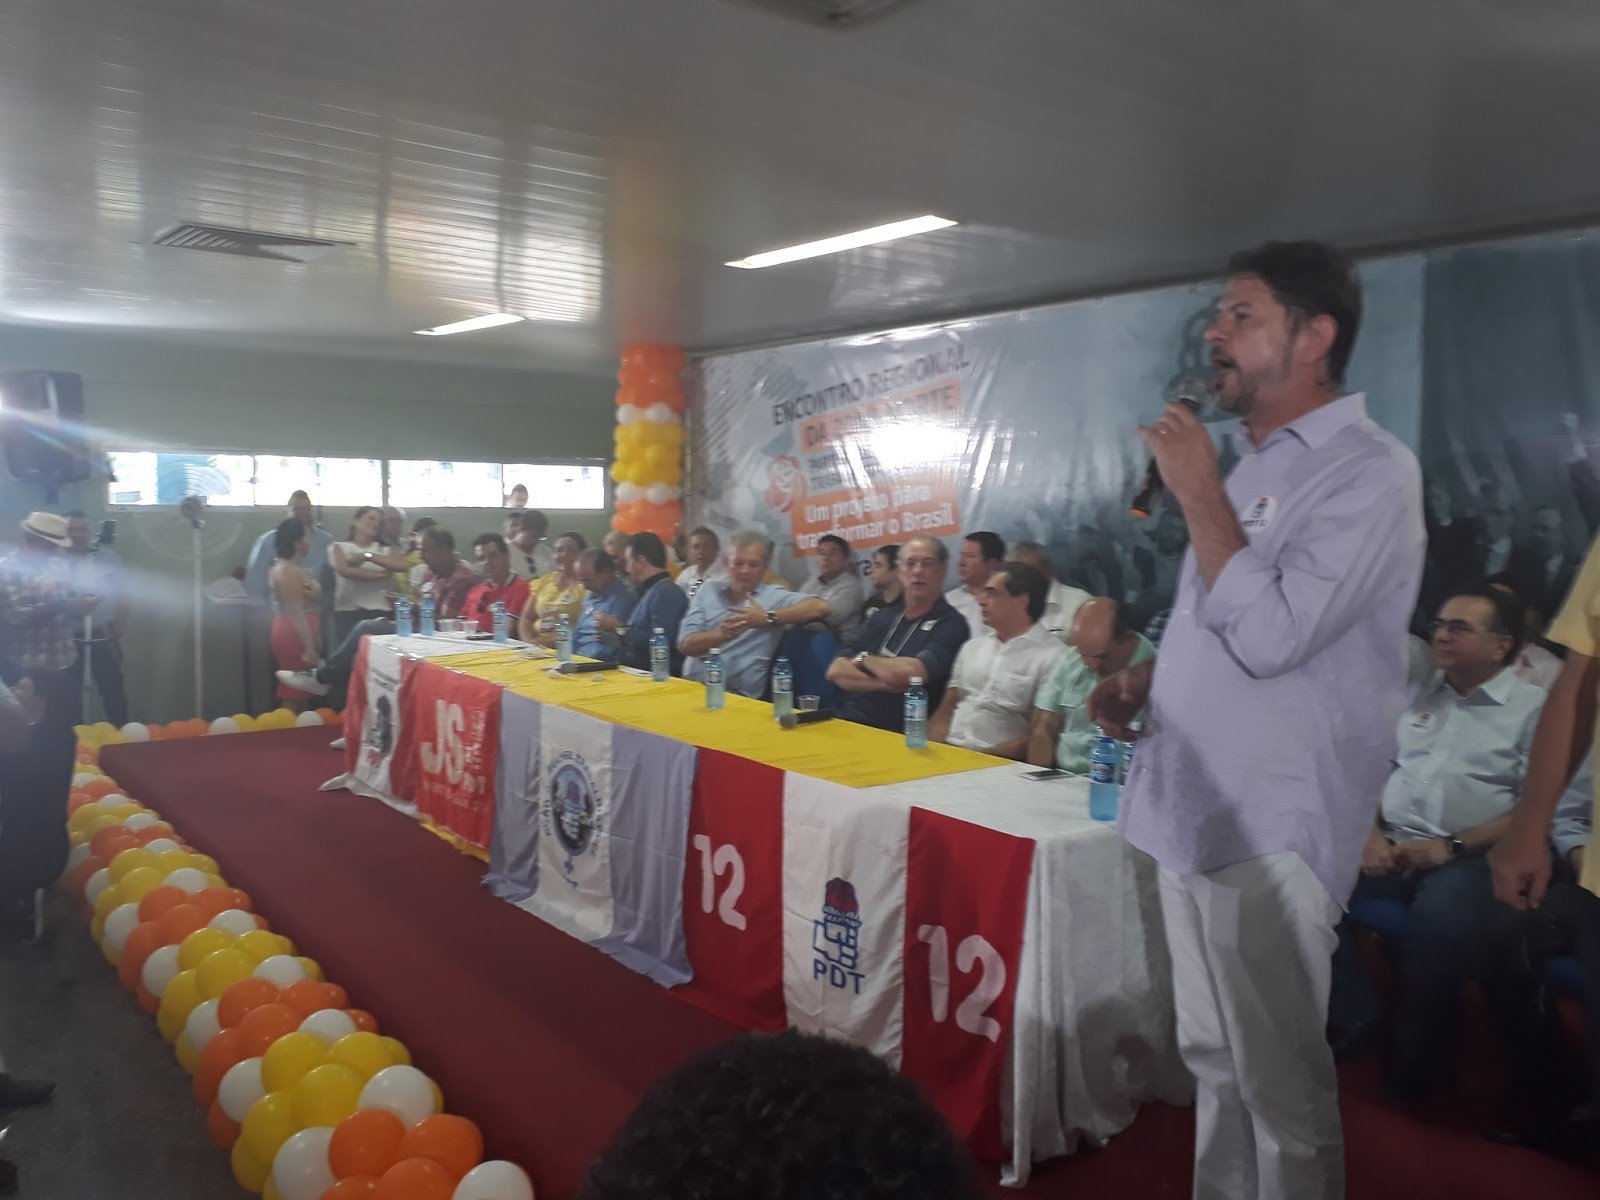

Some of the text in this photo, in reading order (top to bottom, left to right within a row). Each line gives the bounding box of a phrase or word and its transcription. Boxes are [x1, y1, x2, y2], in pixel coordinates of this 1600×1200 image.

[773, 378, 864, 425] ENCONTRO
[804, 504, 830, 523] Um
[886, 518, 900, 535] o
[903, 502, 955, 532] Brasil
[420, 699, 465, 784] JS
[694, 834, 747, 931] 12
[813, 958, 865, 994] PDT
[917, 924, 1006, 1043] 12
